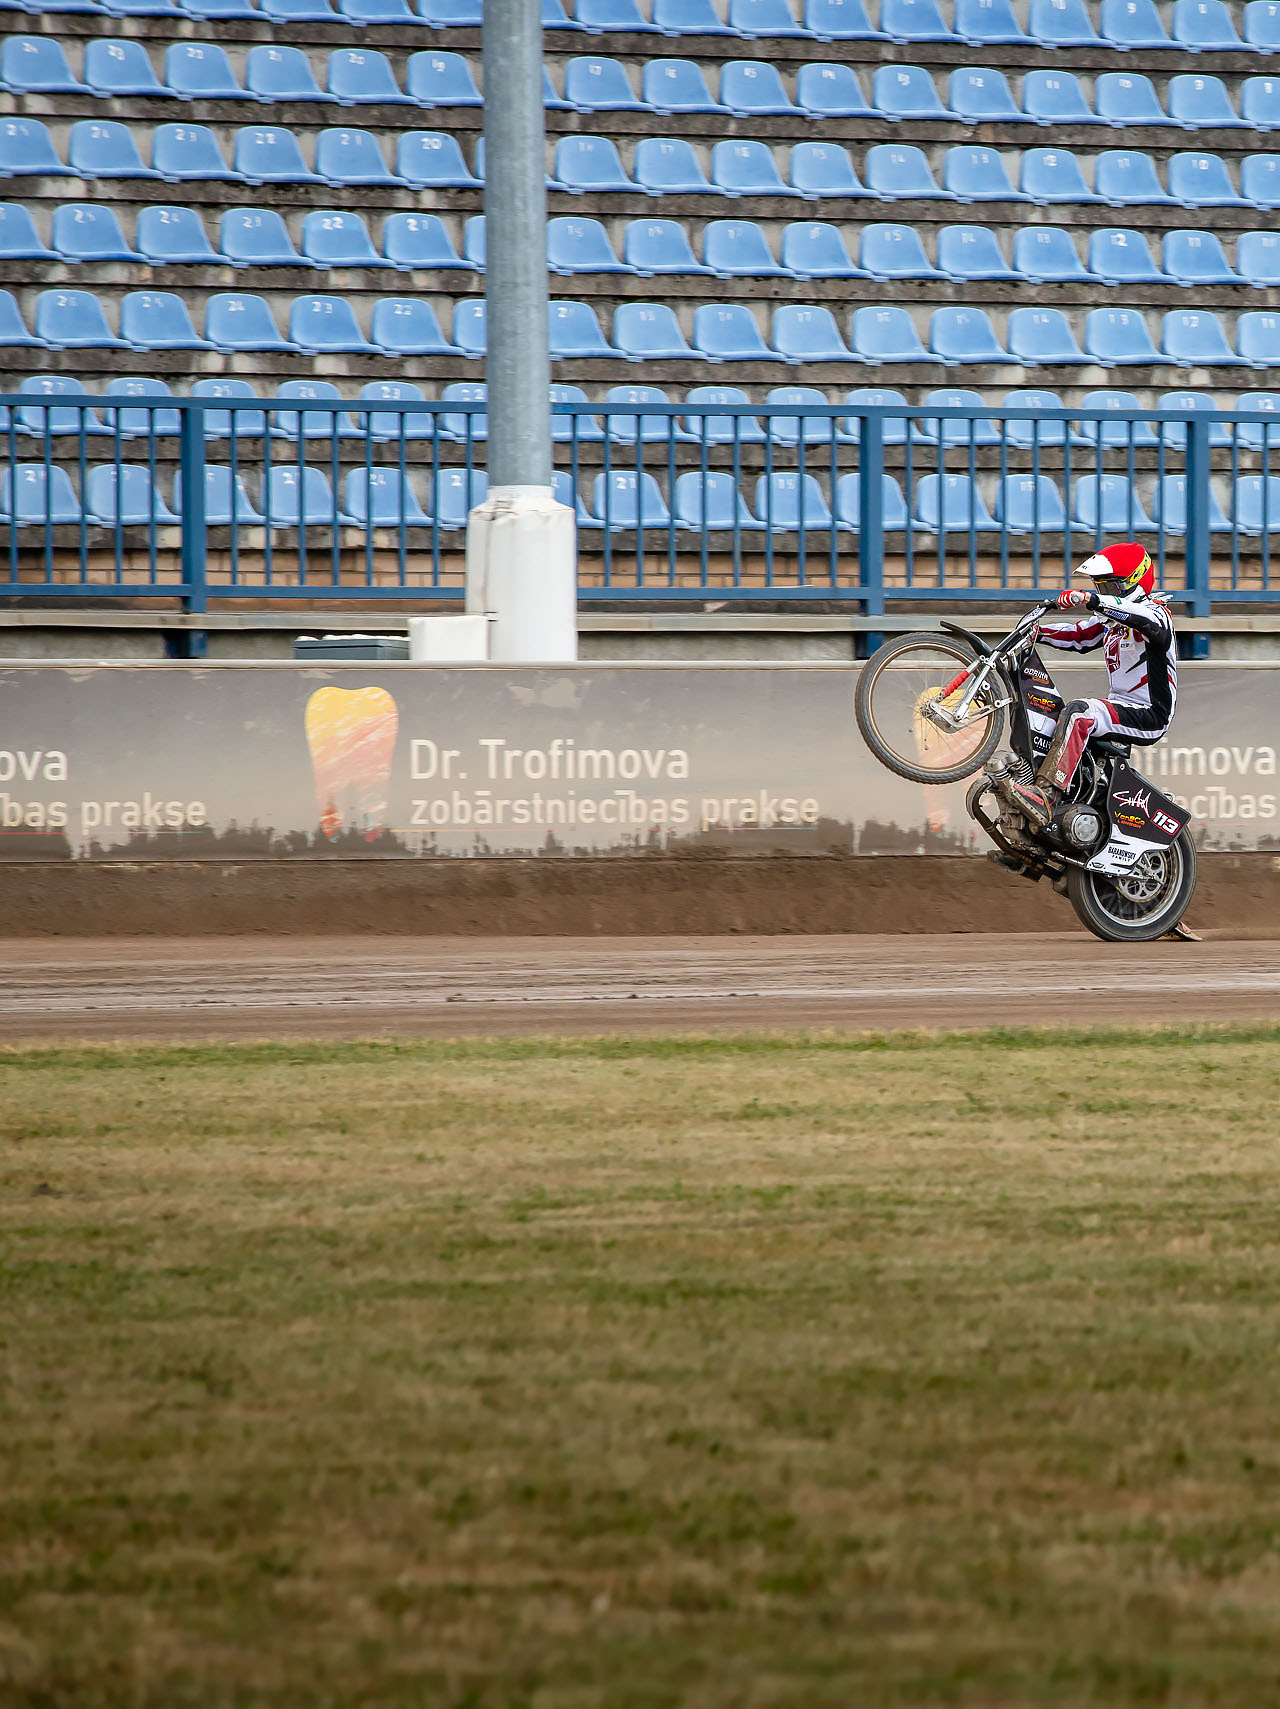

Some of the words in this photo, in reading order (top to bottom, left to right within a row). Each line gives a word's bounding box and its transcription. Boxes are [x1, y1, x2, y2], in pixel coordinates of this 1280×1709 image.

[969, 76, 984, 88] 12
[340, 133, 362, 145] 21
[421, 137, 442, 150] 20
[322, 216, 344, 230] 22
[406, 218, 429, 232] 21
[1109, 233, 1128, 247] 12
[615, 476, 637, 490] 21
[410, 739, 467, 780] Dr.
[479, 739, 689, 780] Trofimova
[81, 791, 206, 836] prakse
[410, 790, 689, 825] zobārstniecības
[702, 789, 819, 832] prakse
[1152, 811, 1180, 834] 113
